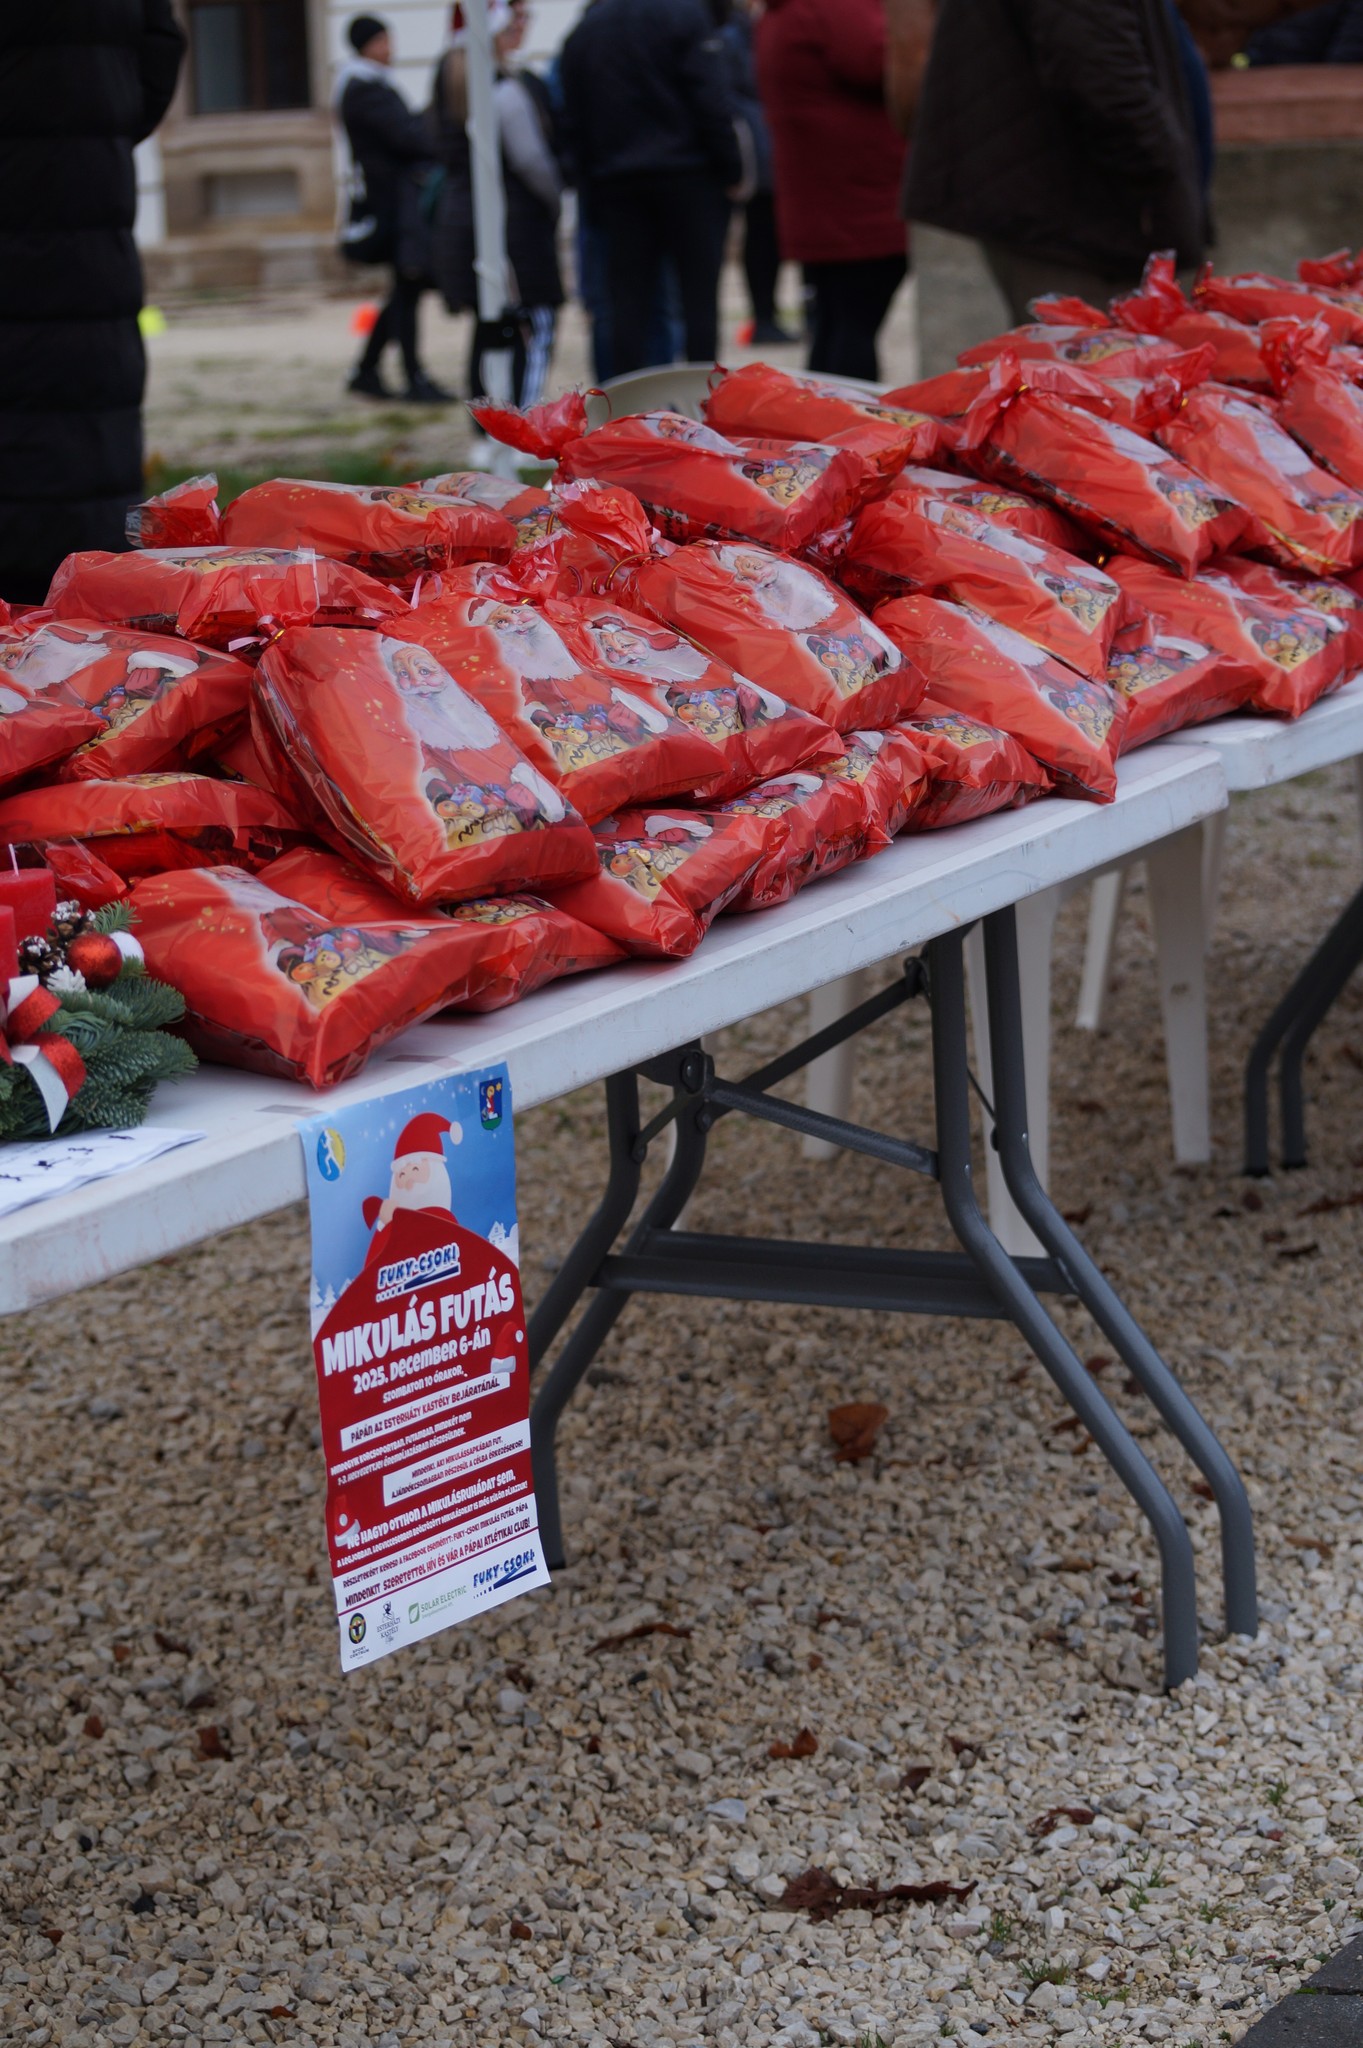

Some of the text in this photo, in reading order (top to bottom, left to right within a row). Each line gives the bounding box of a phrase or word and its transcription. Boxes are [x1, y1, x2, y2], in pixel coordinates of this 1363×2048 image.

[322, 1265, 515, 1378] MIKULÁS FUTÁS
[353, 1363, 388, 1395] 2025.
[425, 1374, 432, 1387] 10
[375, 1420, 382, 1432] AZ
[360, 1520, 389, 1544] HAGYD
[422, 1504, 428, 1517] A
[446, 1547, 458, 1562] VÁR
[460, 1545, 464, 1556] A
[465, 1537, 482, 1554] PÁPAI
[421, 1596, 438, 1612] SOLAR
[441, 1585, 466, 1603] ELECTRIC
